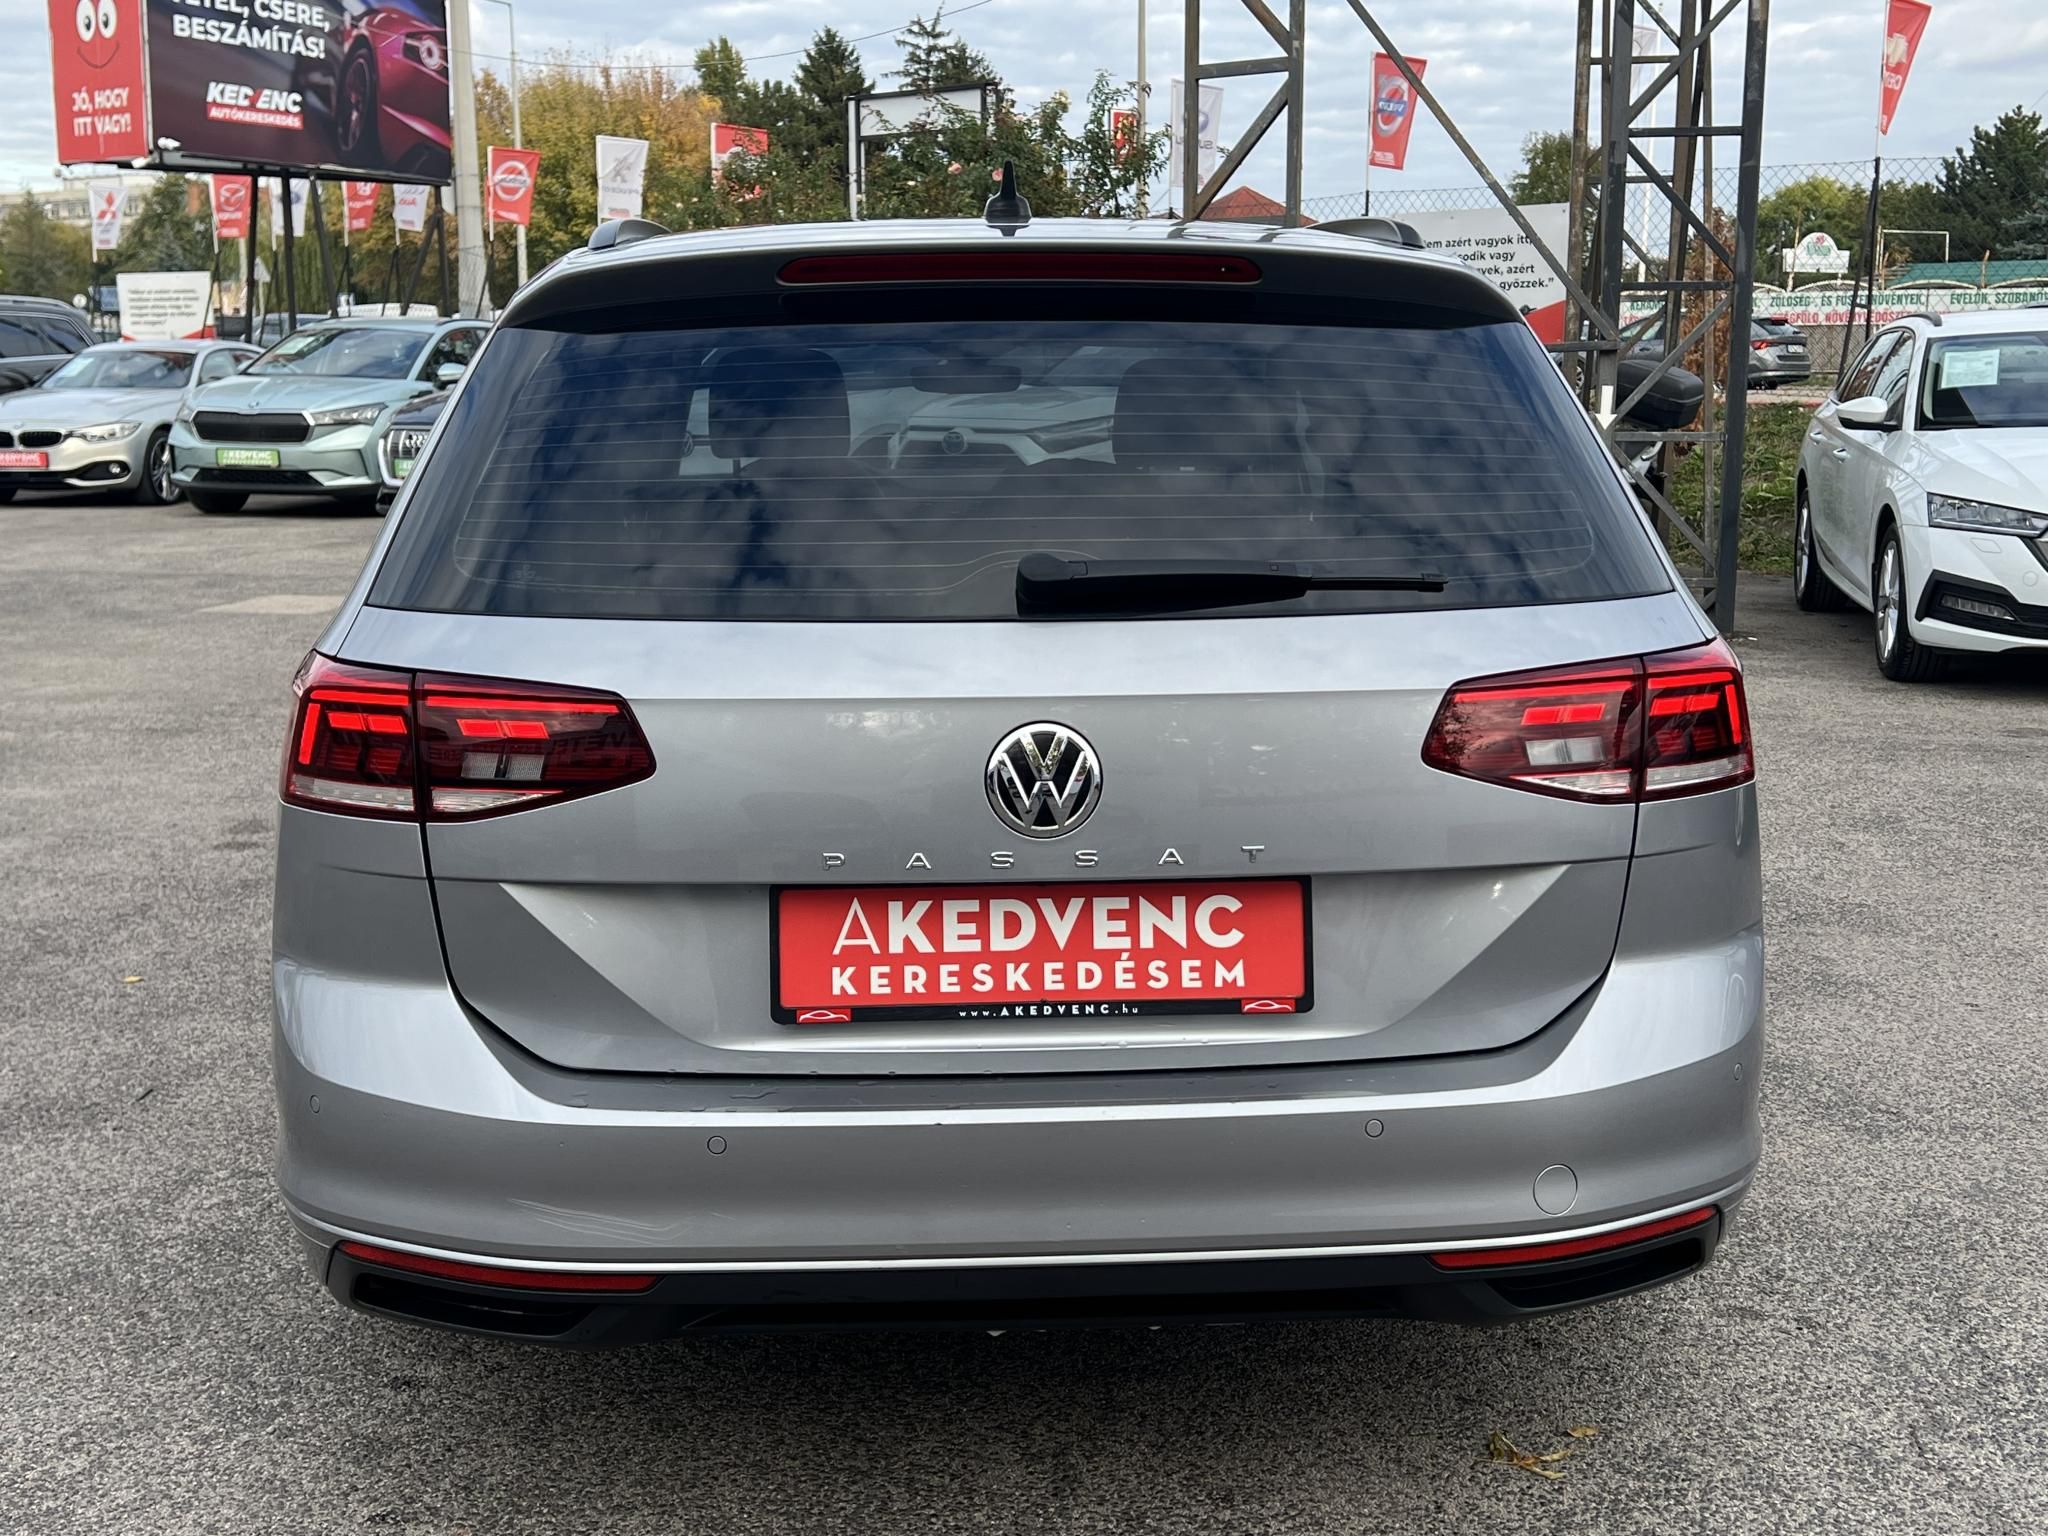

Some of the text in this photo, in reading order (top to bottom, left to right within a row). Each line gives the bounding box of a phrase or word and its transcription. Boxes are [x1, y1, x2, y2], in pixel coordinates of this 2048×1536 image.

[253, 0, 330, 32] CSERE,
[173, 14, 325, 59] BESZÁMÍTÁS!
[71, 86, 129, 114] JÓ, HOGY
[73, 113, 131, 137] ITT VAGY!
[1424, 239, 1442, 249] em
[1445, 236, 1471, 248] azért
[1475, 234, 1514, 248] vagyok
[1489, 251, 1516, 262] vagy
[1506, 263, 1535, 274] azért
[823, 845, 1265, 870] PASSAT
[832, 952, 1246, 996] KERESKEDÉSEM
[959, 1003, 1138, 1017] www.AKEDVENC.hu
